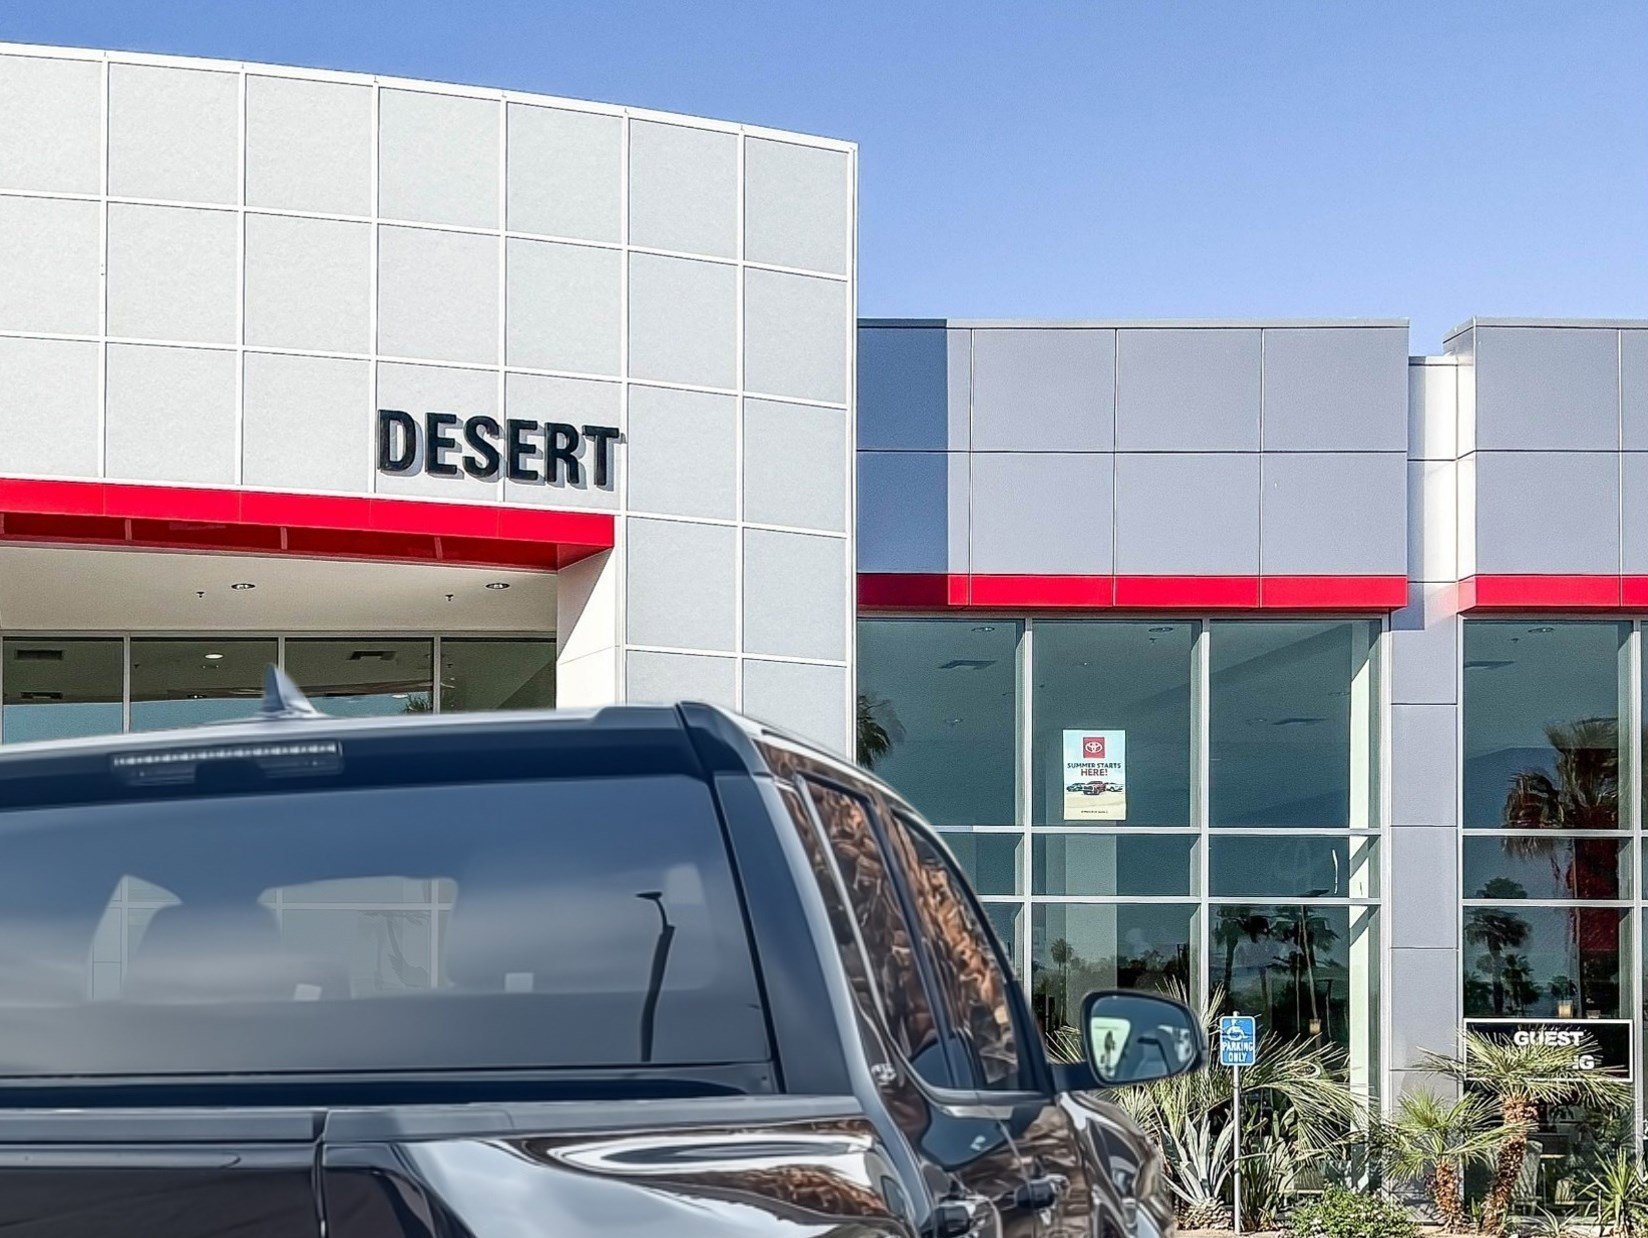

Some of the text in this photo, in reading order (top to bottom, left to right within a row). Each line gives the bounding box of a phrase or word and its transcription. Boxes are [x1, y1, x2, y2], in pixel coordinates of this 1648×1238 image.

[377, 409, 620, 487] DESERT
[1513, 1030, 1584, 1047] GUEST
[1222, 1041, 1253, 1052] PARKING
[1228, 1052, 1248, 1062] ONLY
